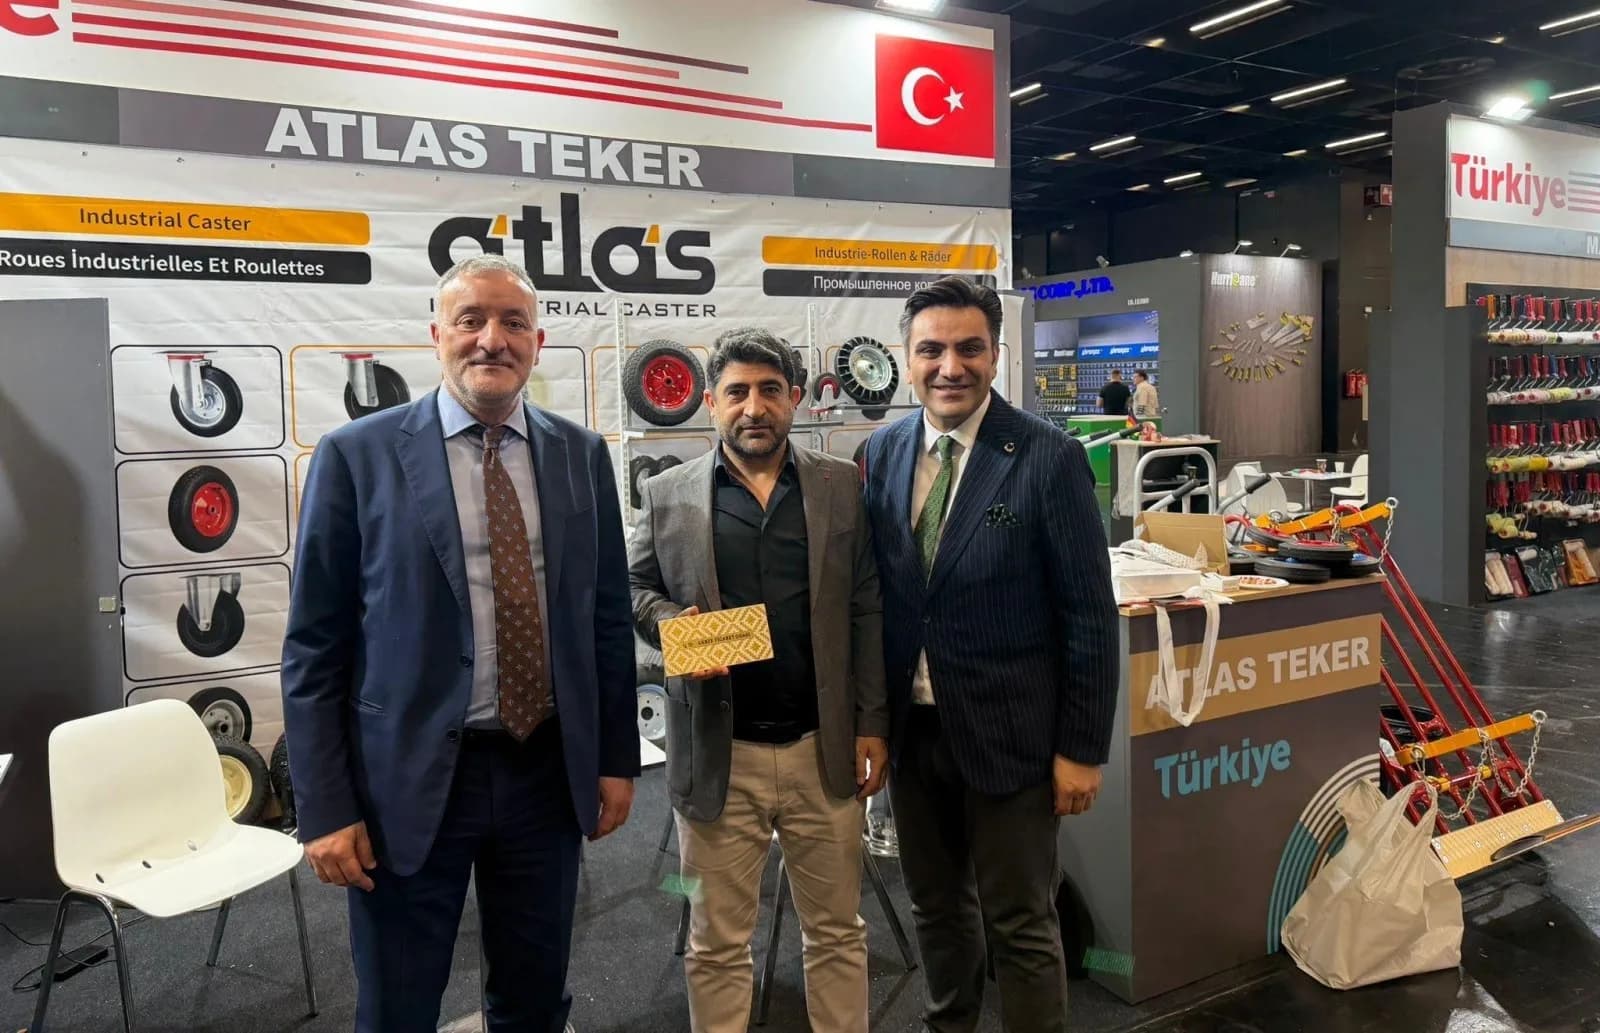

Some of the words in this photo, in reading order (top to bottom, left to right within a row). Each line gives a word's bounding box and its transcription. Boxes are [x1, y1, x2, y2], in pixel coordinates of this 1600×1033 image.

[265, 107, 488, 169] ATLAS
[507, 129, 703, 188] TEKER
[1451, 153, 1567, 217] Türkiye
[79, 207, 182, 229] Industrial
[187, 213, 251, 232] Caster
[428, 191, 716, 296] atlas
[0, 250, 66, 268] Roues
[208, 257, 230, 274] Et
[234, 257, 325, 277] Roulettes
[814, 246, 907, 262] Industrie-Rollen
[909, 252, 918, 262] &
[920, 250, 952, 264] Räder
[813, 275, 911, 292] Промышленное
[1267, 636, 1370, 684] TEKER
[1153, 737, 1292, 799] Türkiye
